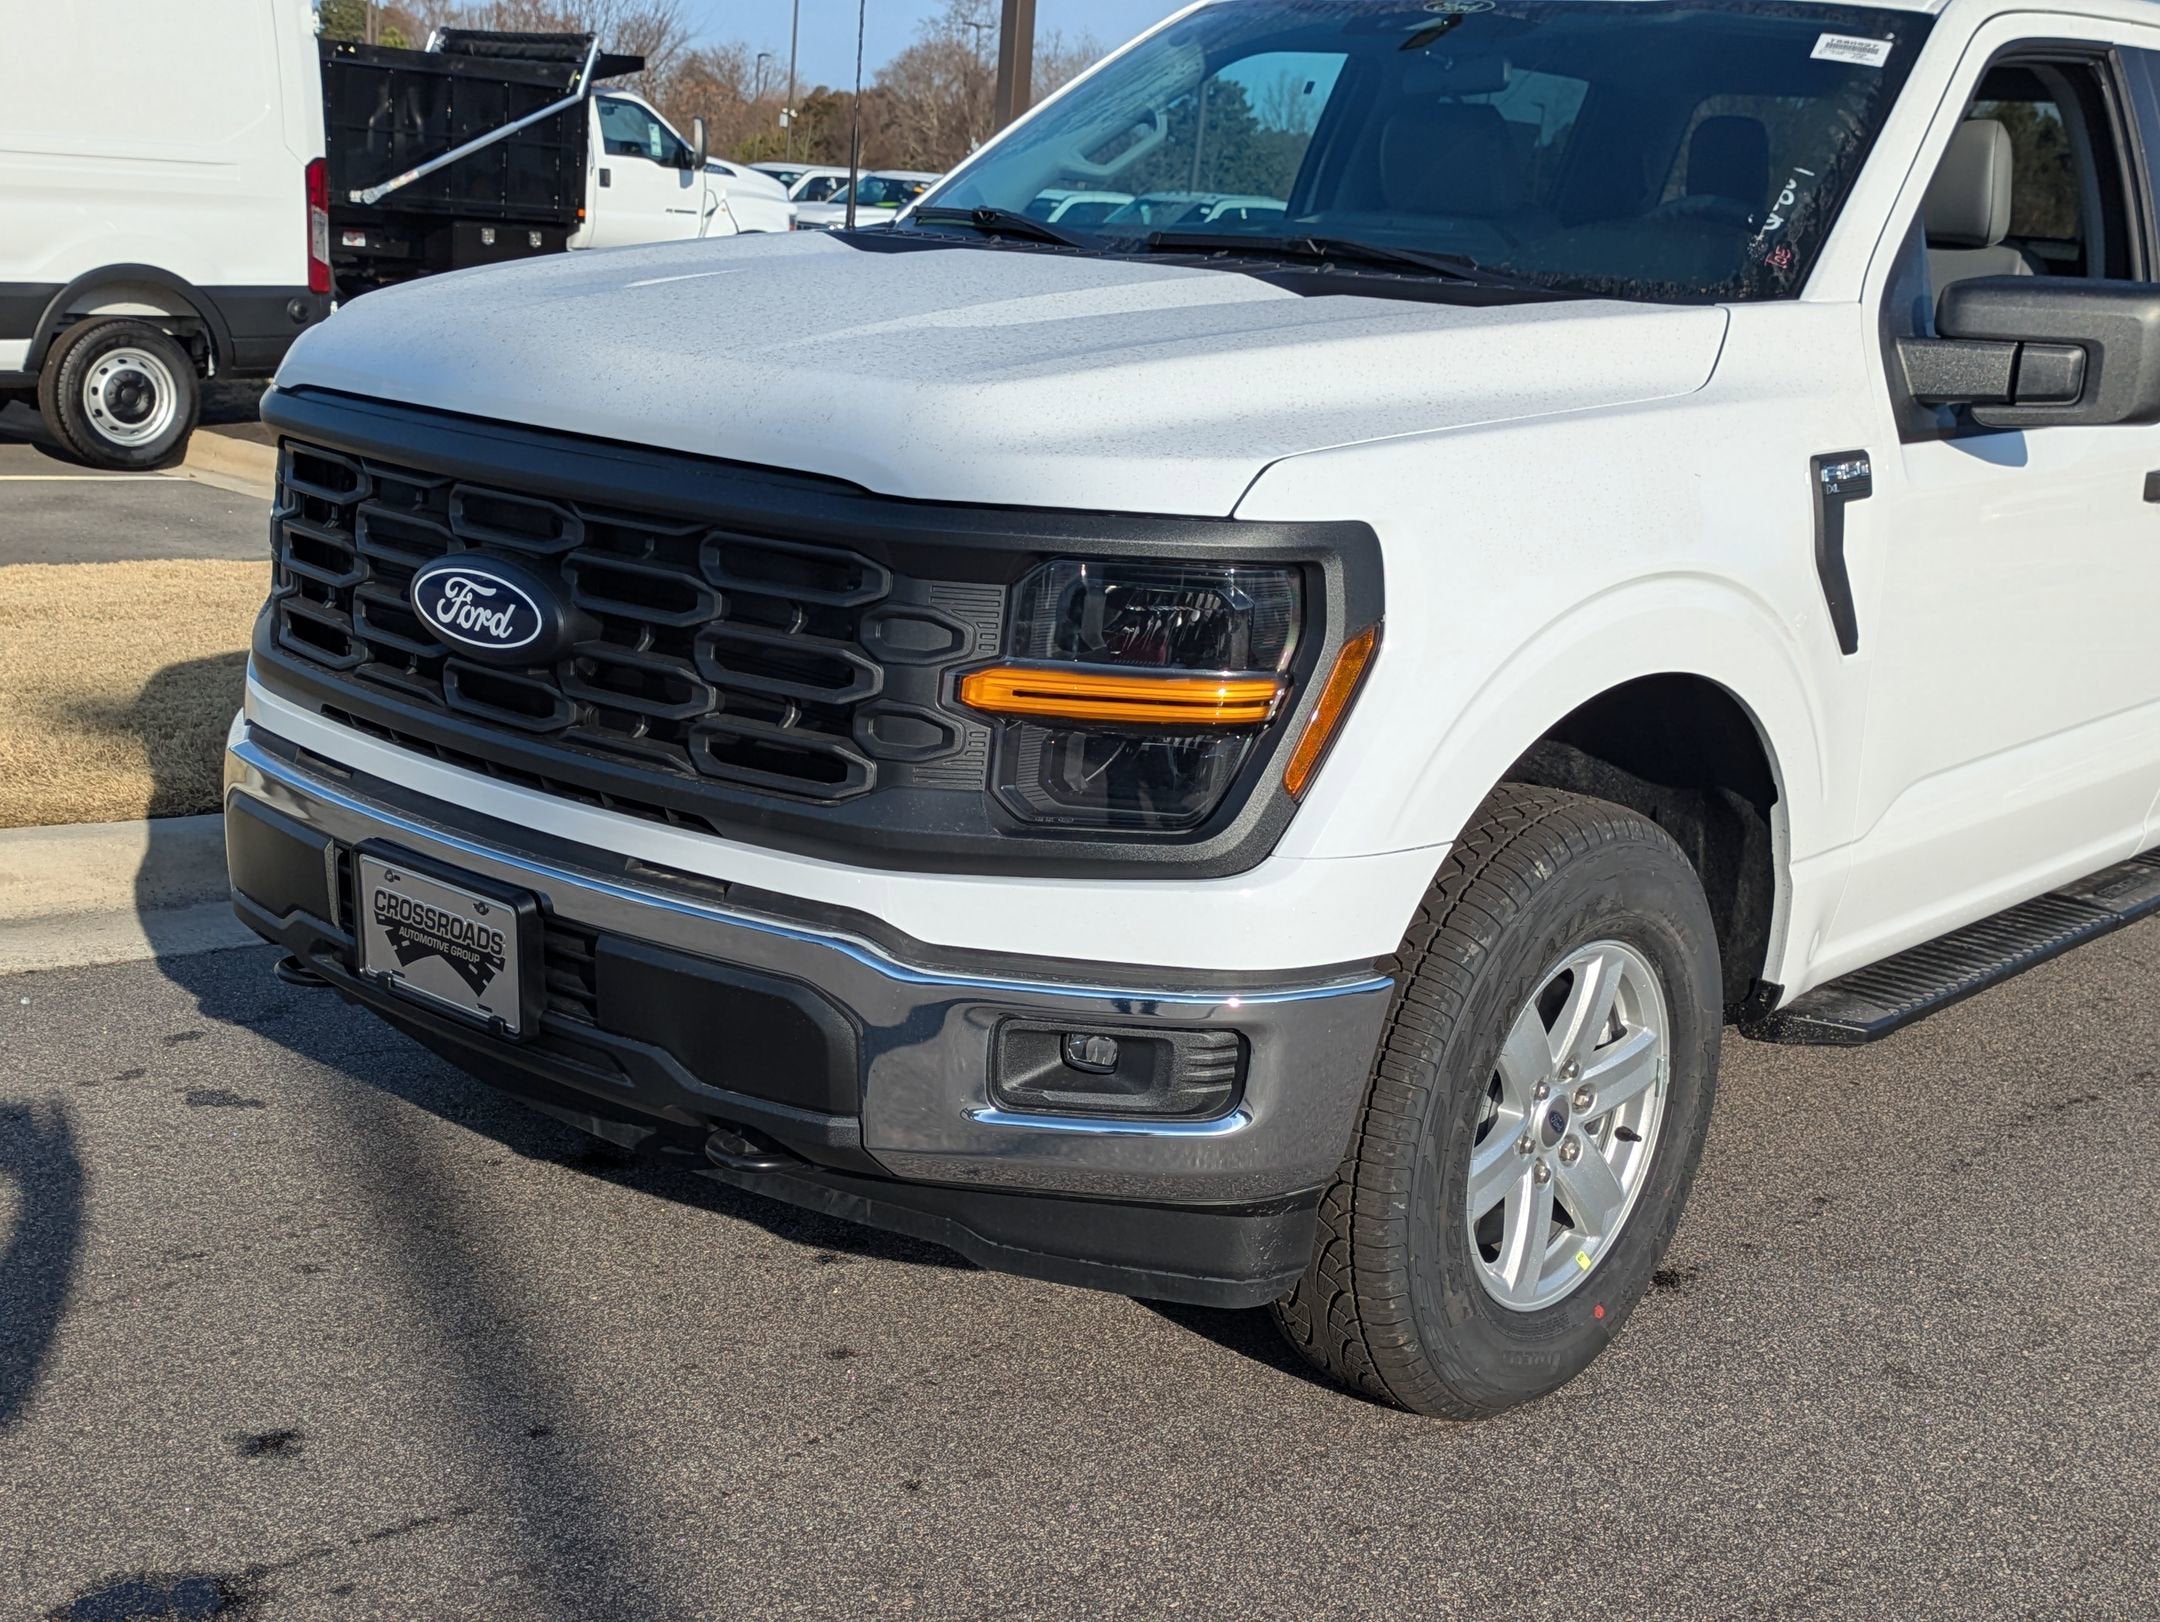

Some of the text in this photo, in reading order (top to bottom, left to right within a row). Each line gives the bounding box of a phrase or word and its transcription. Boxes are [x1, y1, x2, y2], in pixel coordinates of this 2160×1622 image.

[436, 576, 517, 639] Ford
[374, 889, 505, 957] CROSSROADS
[398, 926, 481, 965] AUTOMOTIVE GROUP
